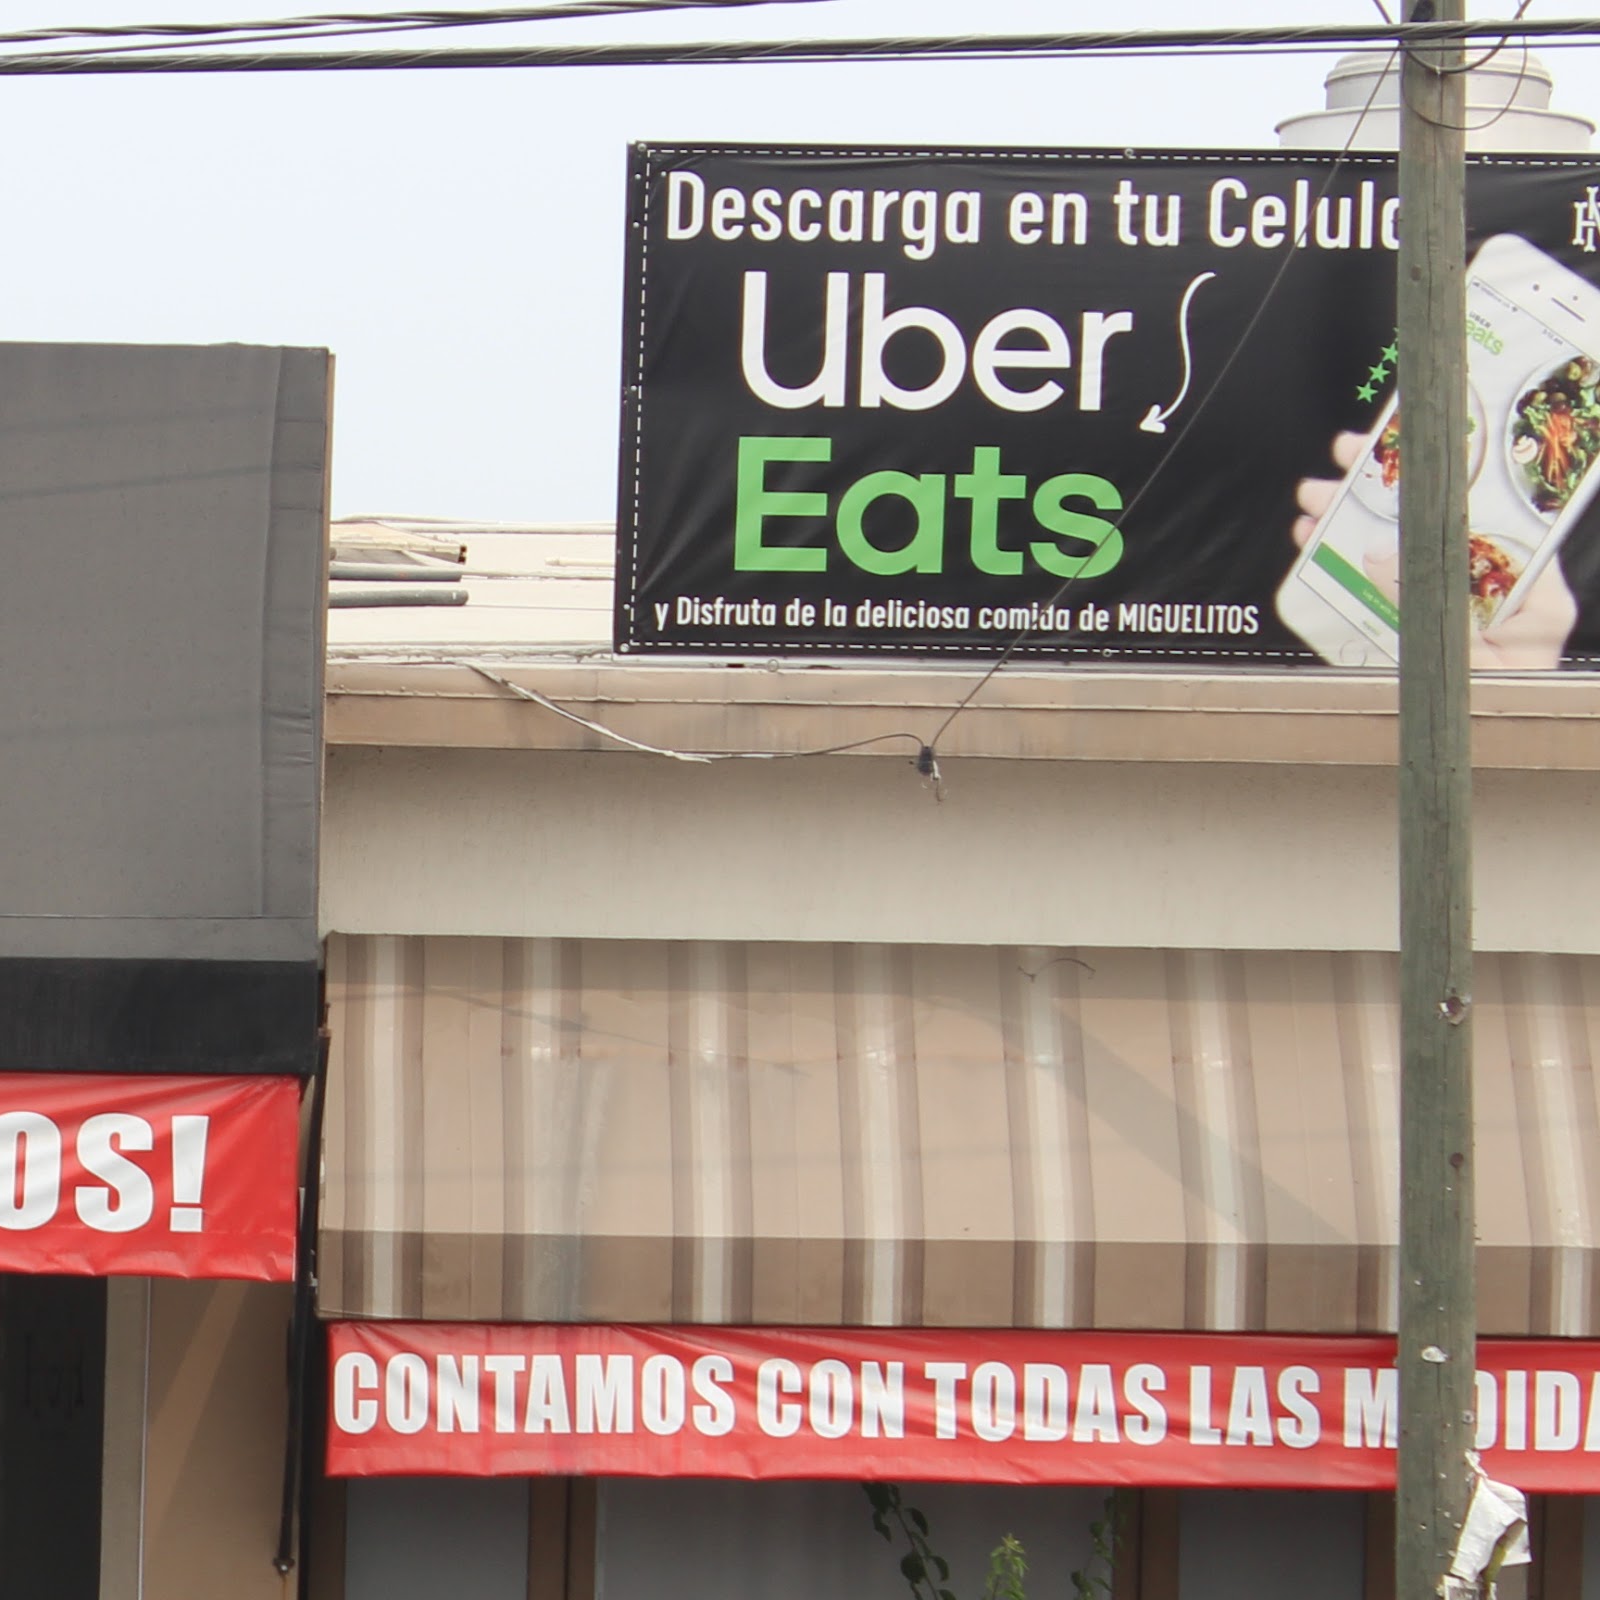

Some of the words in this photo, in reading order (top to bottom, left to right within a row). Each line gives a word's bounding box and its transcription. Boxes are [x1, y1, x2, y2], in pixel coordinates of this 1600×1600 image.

[663, 171, 982, 259] Descarga
[1010, 193, 1089, 246] en
[1114, 181, 1182, 248] tu
[1210, 179, 1399, 250] Celul
[742, 271, 1133, 412] Uber
[734, 435, 1124, 579] Eats
[655, 604, 670, 632] y
[677, 597, 778, 627] Disfruta
[786, 598, 817, 628] de
[825, 599, 848, 628] la
[857, 600, 971, 630] deliciosa
[979, 602, 1071, 632] comida
[1080, 603, 1111, 633] de
[1119, 604, 1260, 635] MIGUELITOS
[333, 1350, 738, 1437] CONTAMOS
[756, 1358, 906, 1440] CON
[925, 1361, 1168, 1446] TODAS
[1190, 1365, 1322, 1449] LAS
